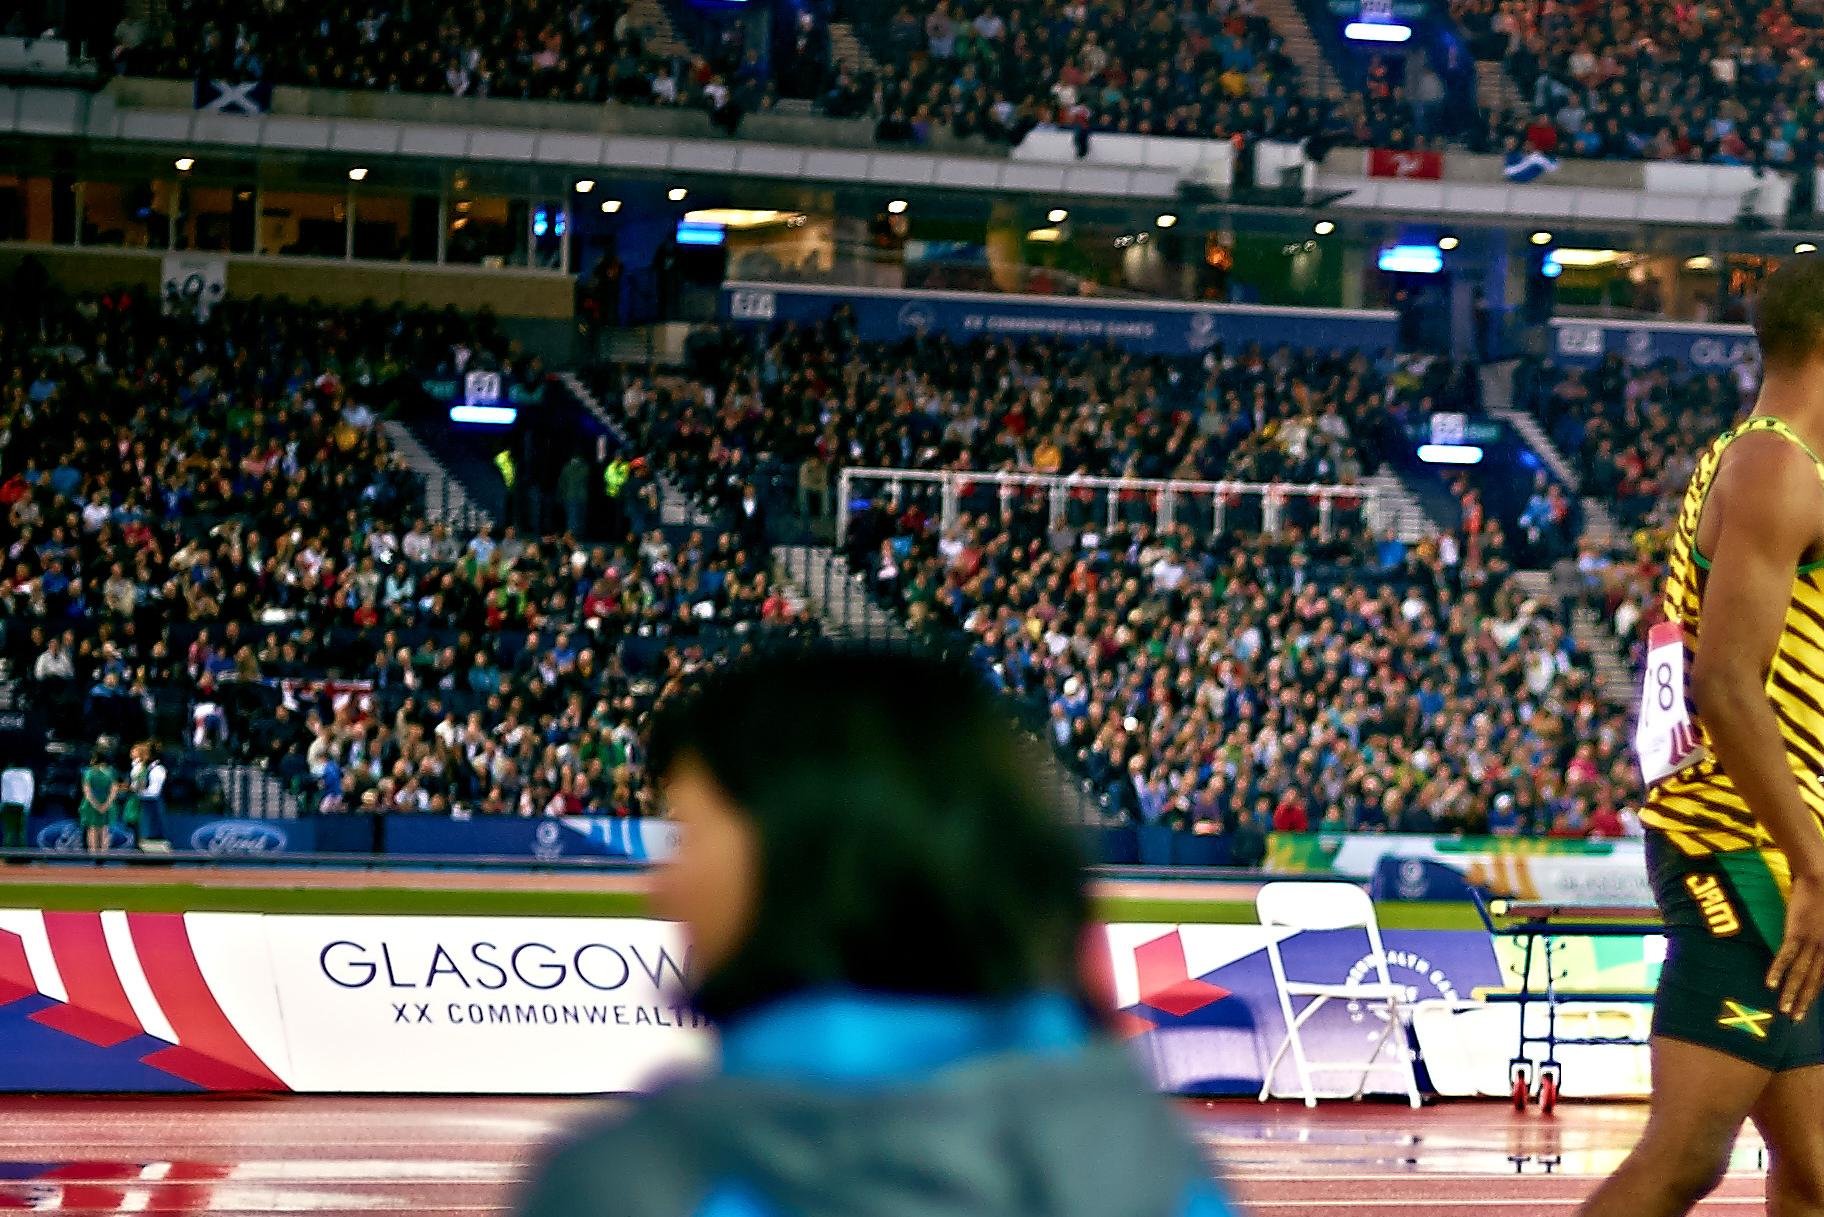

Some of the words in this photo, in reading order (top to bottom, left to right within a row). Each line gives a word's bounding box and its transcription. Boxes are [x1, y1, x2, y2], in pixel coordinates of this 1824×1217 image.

[1657, 662, 1674, 711] 8
[1684, 874, 1741, 935] JAM
[319, 940, 694, 991] GLASGOW
[391, 1003, 433, 1025] XX
